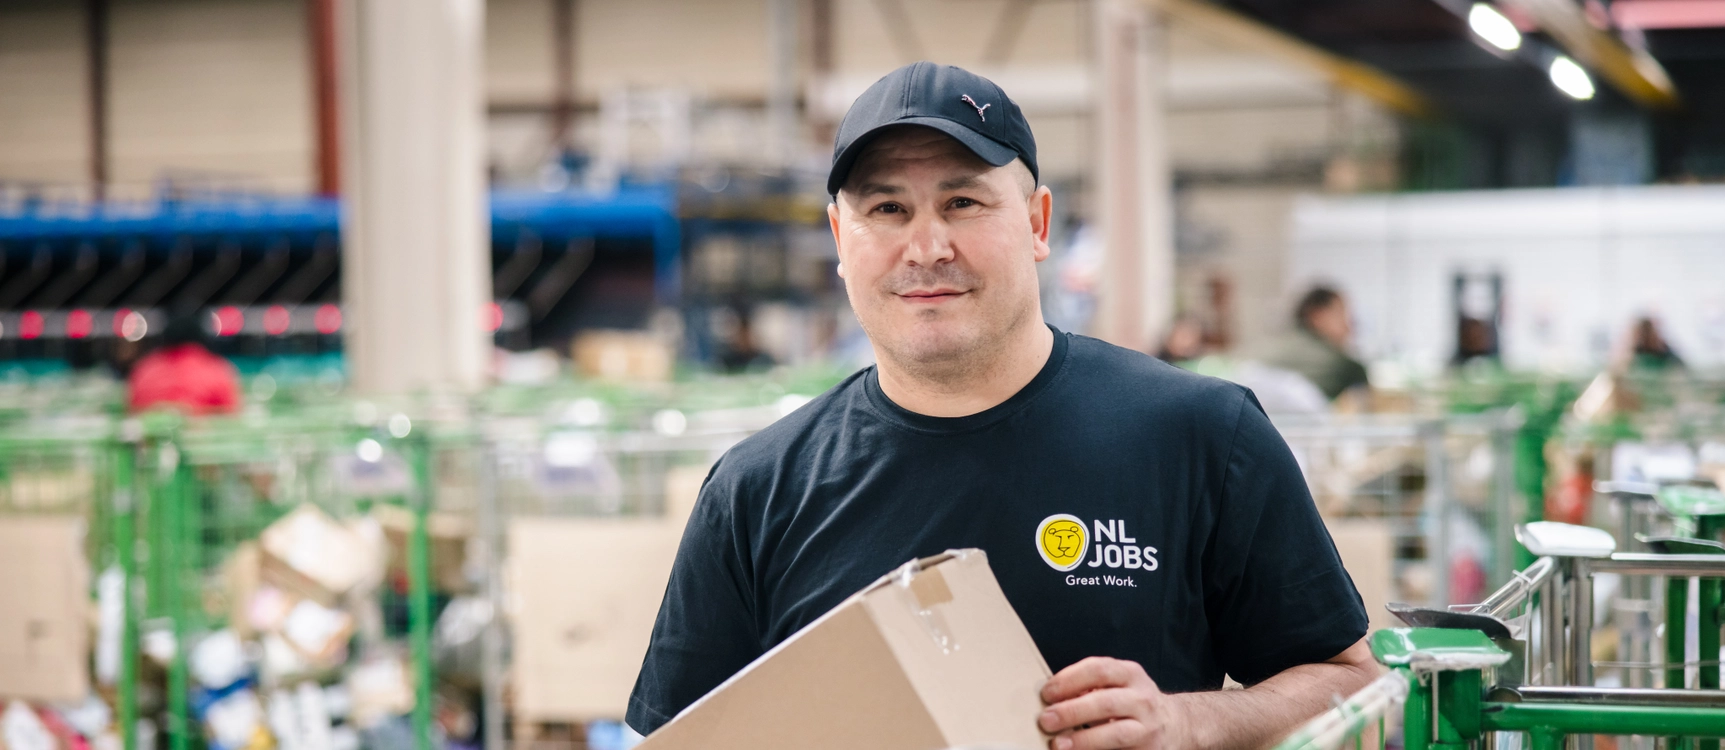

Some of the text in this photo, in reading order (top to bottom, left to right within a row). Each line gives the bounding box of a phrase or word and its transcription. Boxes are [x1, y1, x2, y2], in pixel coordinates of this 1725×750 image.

[1094, 519, 1136, 543] NL
[1087, 544, 1159, 571] JOBS
[1065, 575, 1137, 587] Great Work.
